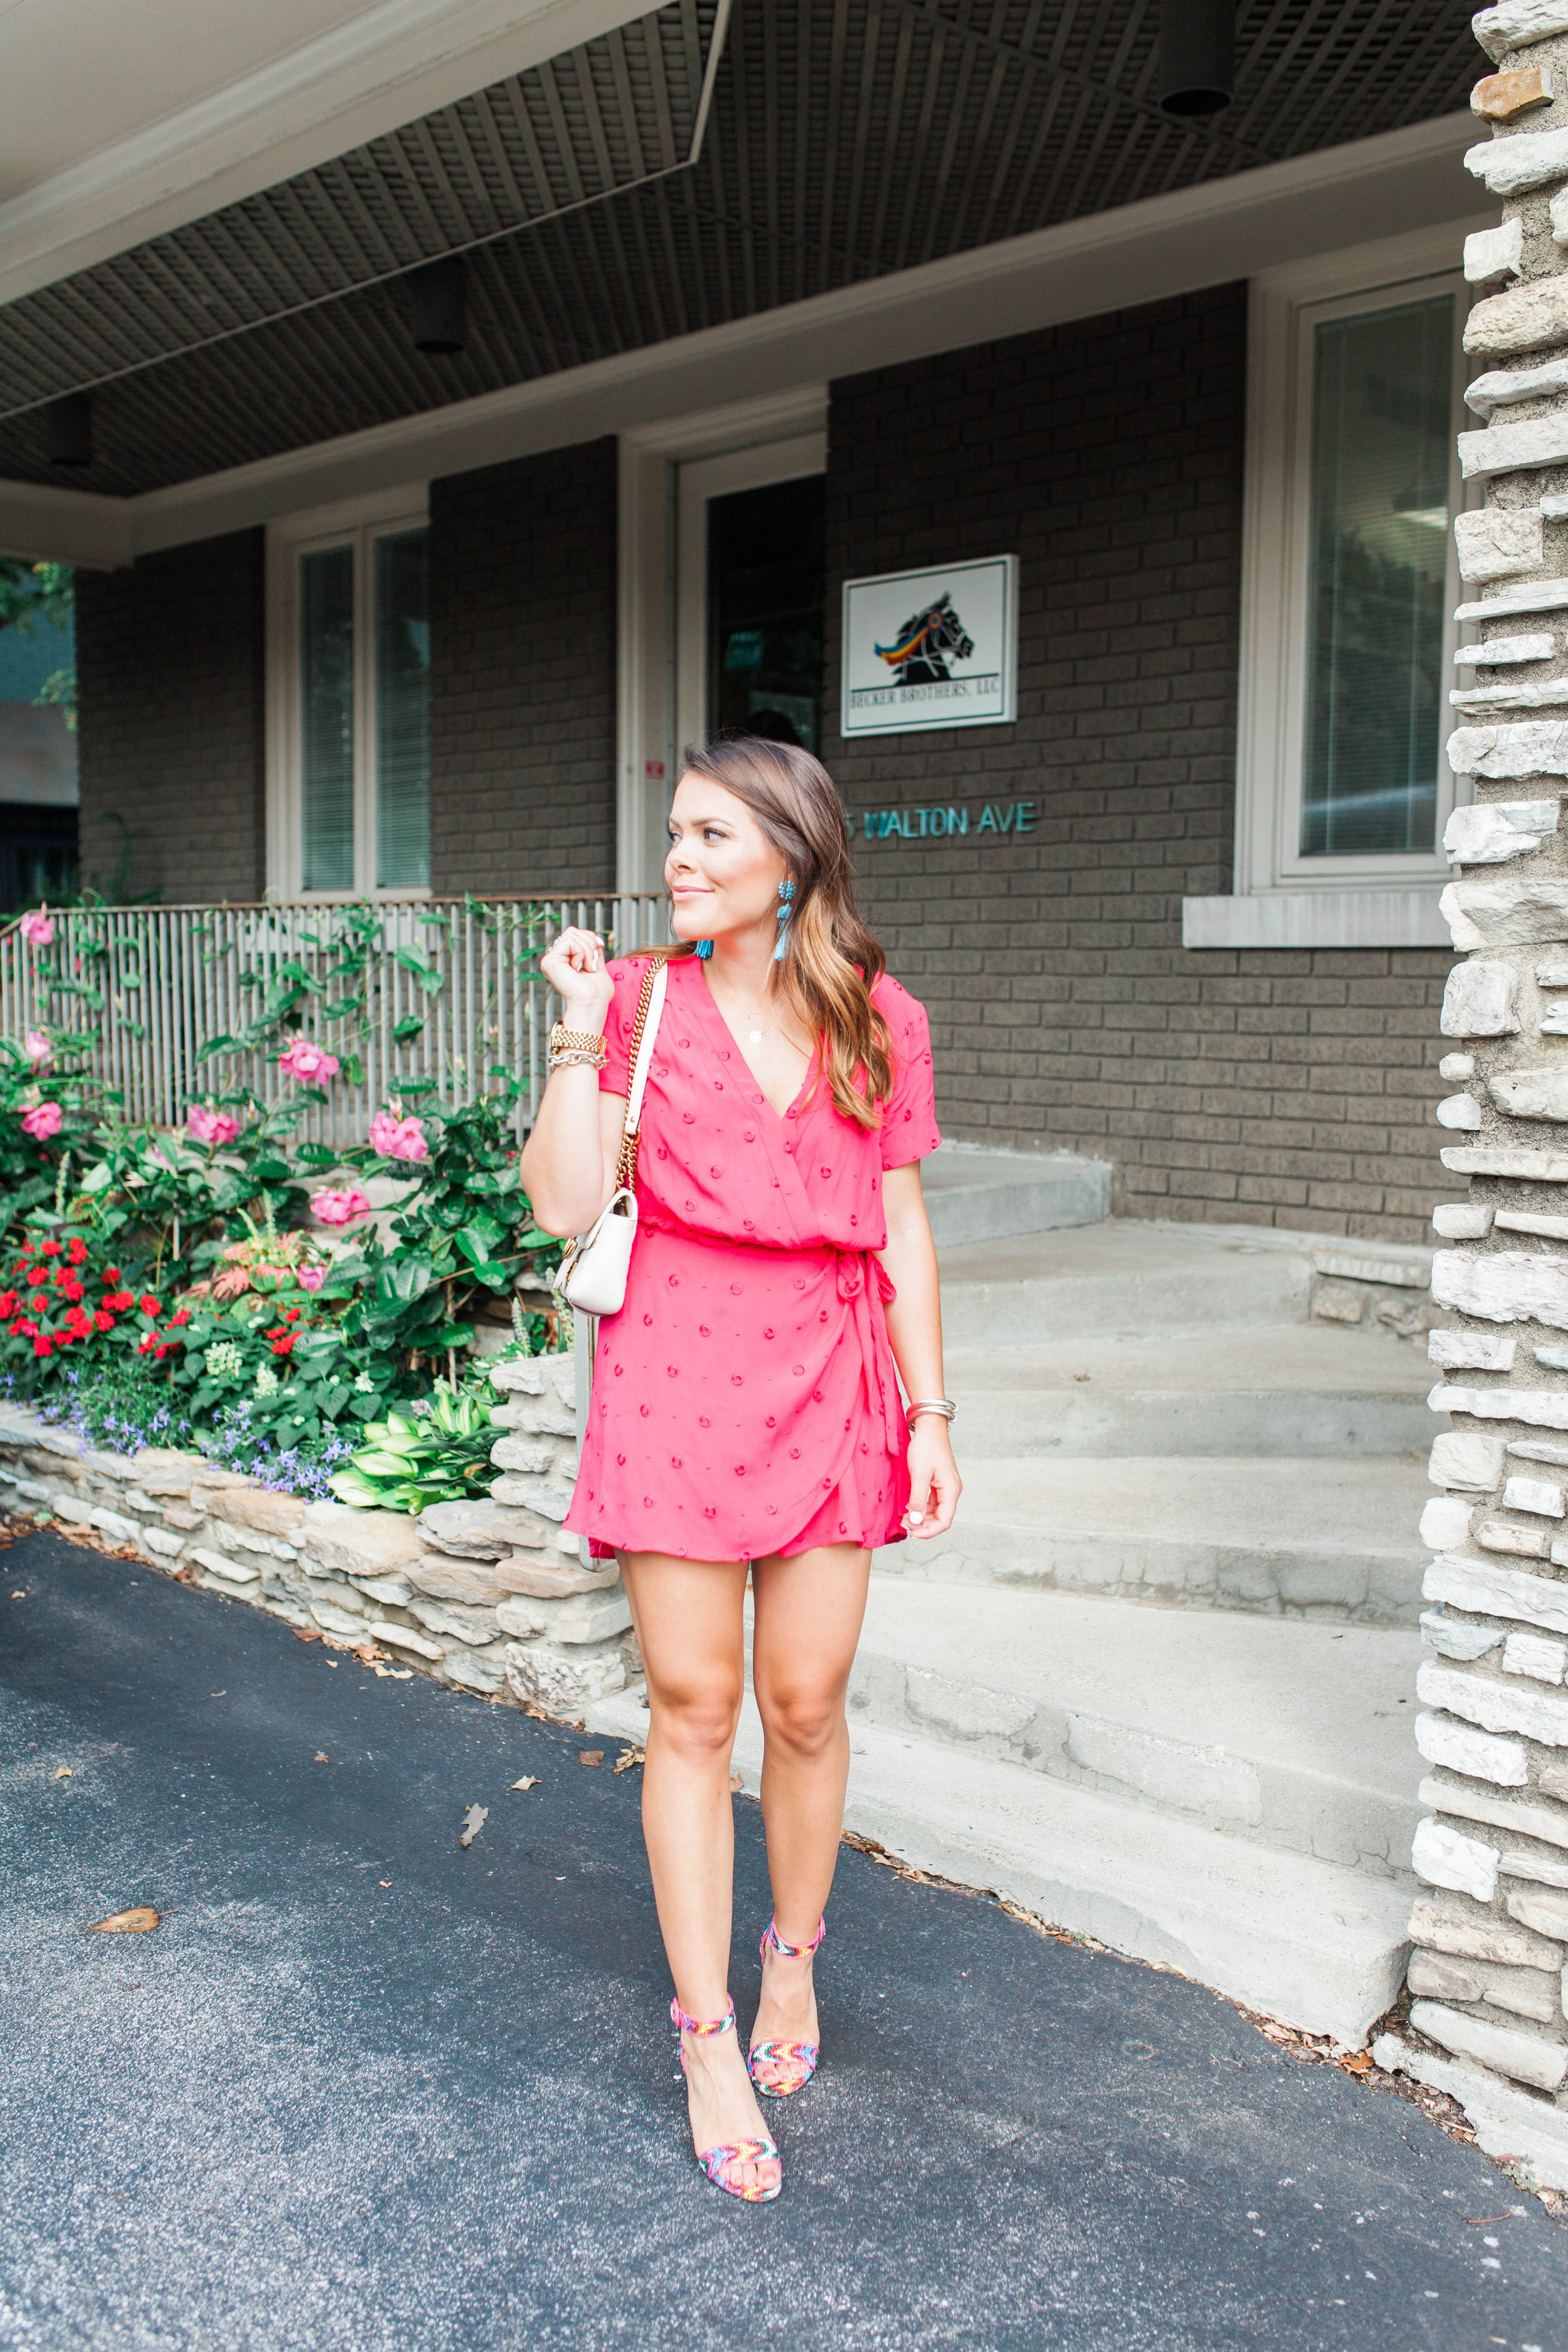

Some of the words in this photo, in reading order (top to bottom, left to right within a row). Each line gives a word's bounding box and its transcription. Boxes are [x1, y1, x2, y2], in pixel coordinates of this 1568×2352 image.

[850, 690, 897, 709] BECKER
[900, 681, 972, 704] BROTHERS,
[976, 677, 1001, 695] LLC
[863, 806, 969, 839] WALTON
[976, 802, 1037, 833] AVE
